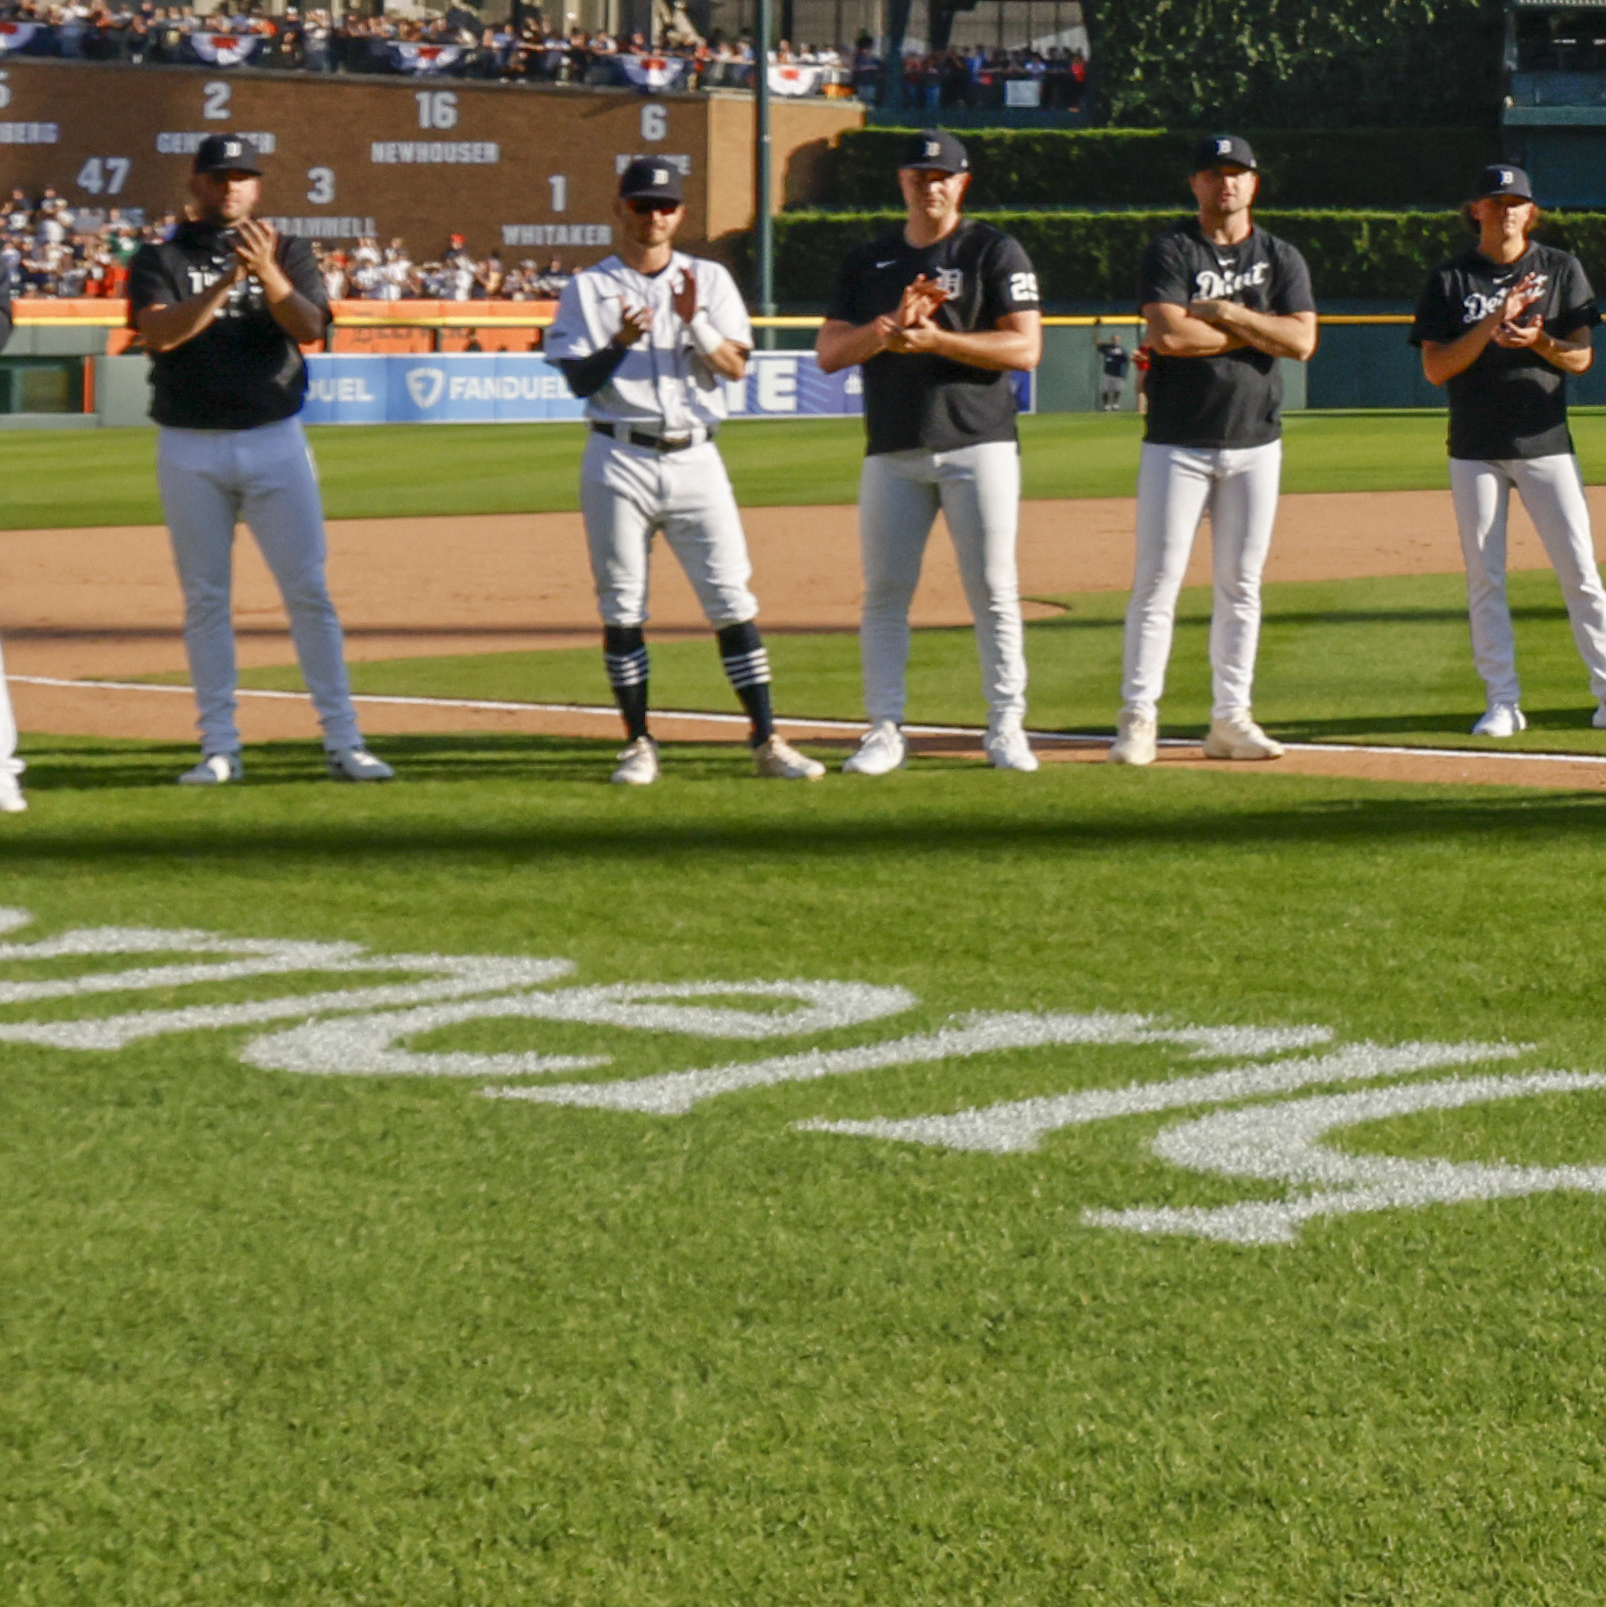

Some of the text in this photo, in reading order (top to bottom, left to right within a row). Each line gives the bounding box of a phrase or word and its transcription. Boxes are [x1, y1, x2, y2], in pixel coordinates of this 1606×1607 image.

[203, 80, 232, 120] 2
[414, 90, 459, 129] 16
[640, 103, 668, 142] 6
[370, 141, 500, 164] NEWHOUSER
[76, 156, 132, 195] 47
[306, 165, 336, 204] 3
[547, 174, 568, 212] 1
[262, 216, 379, 238] RAMMELL
[501, 224, 613, 245] WHITAKER
[449, 375, 579, 401] FANDUEL
